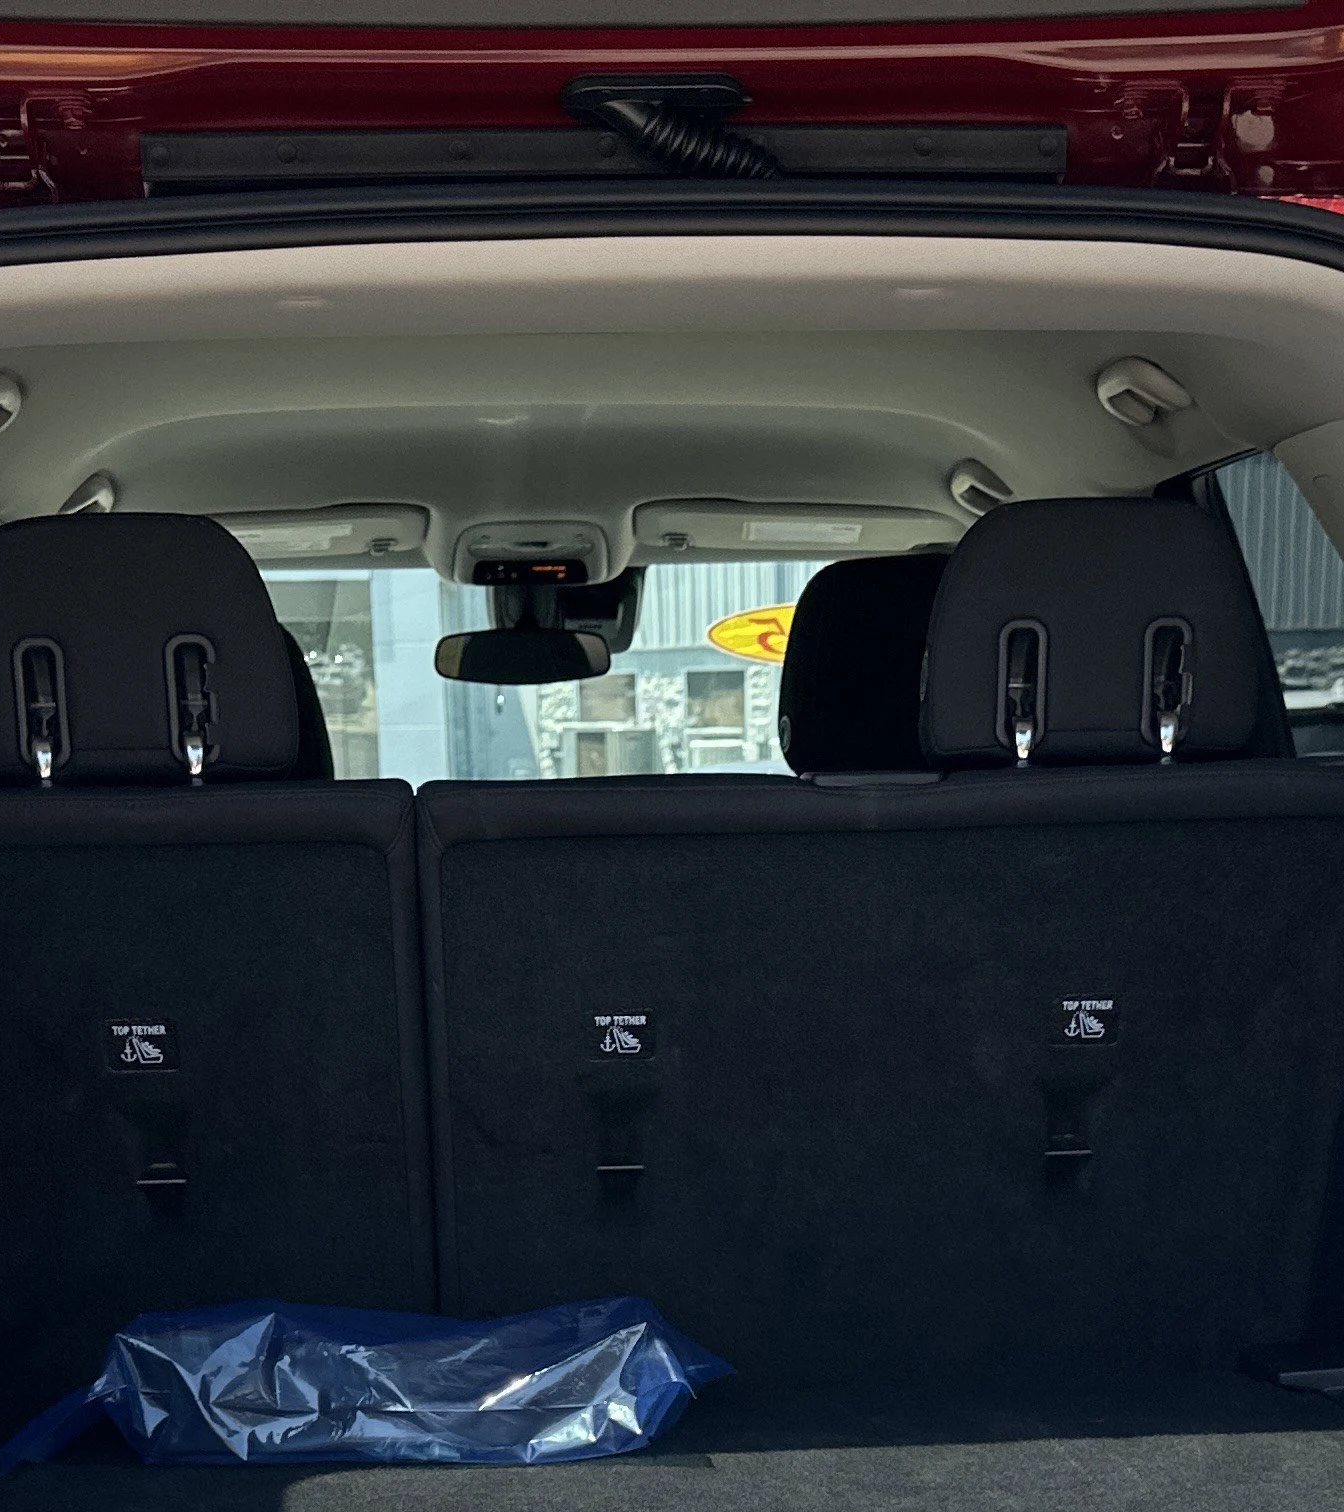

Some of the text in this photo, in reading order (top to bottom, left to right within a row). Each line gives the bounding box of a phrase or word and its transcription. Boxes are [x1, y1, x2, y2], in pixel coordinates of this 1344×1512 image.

[1062, 999, 1114, 1011] TOP TETHER
[594, 1015, 647, 1026] TOP TETHER
[111, 1024, 166, 1036] TOP TETHER
